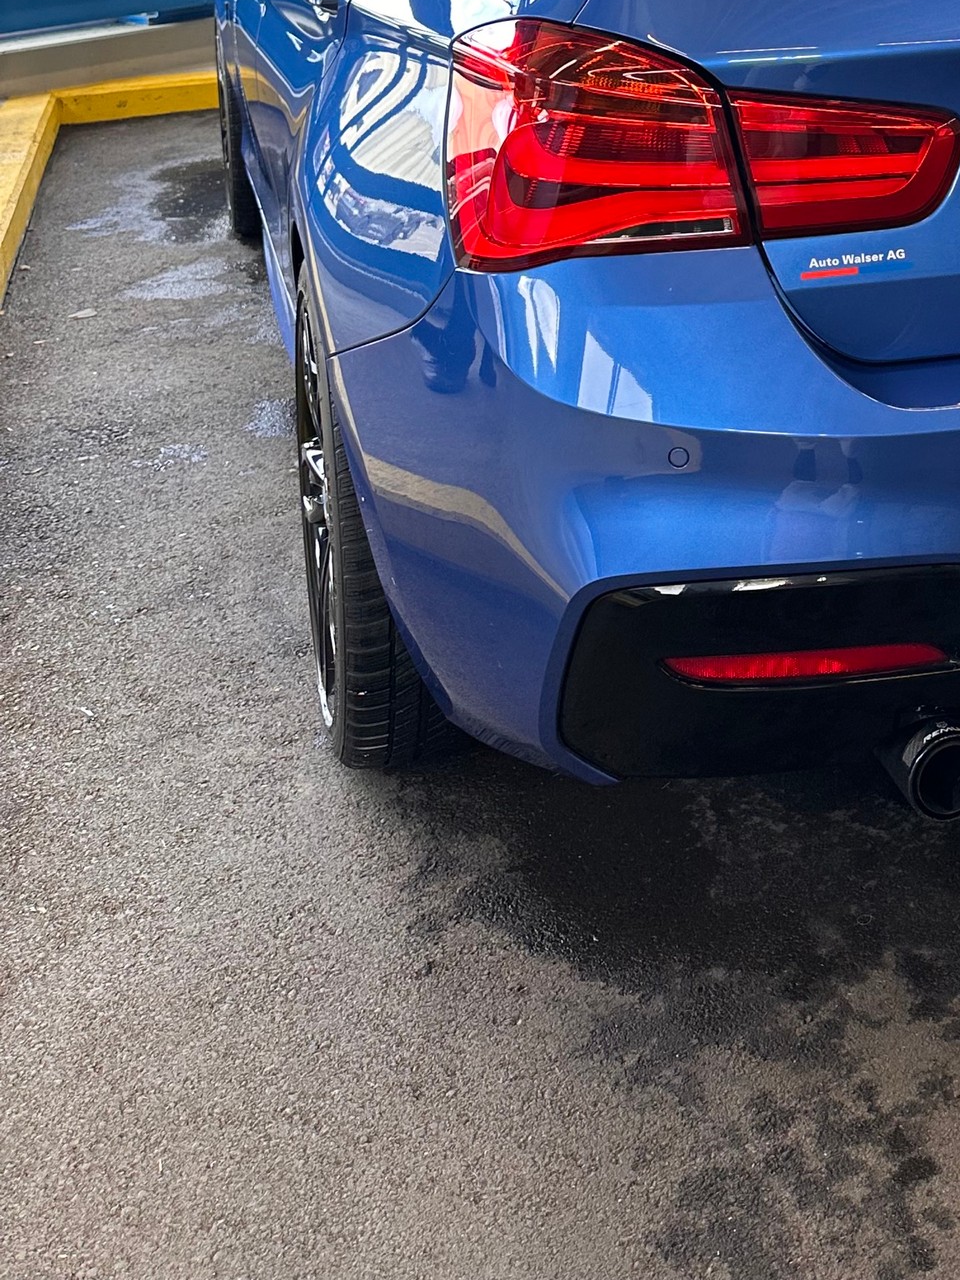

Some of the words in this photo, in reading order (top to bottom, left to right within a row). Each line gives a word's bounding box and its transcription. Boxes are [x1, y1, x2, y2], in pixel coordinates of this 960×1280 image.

[809, 258, 839, 268] Auto
[842, 253, 884, 265] Walser
[886, 249, 906, 260] AG
